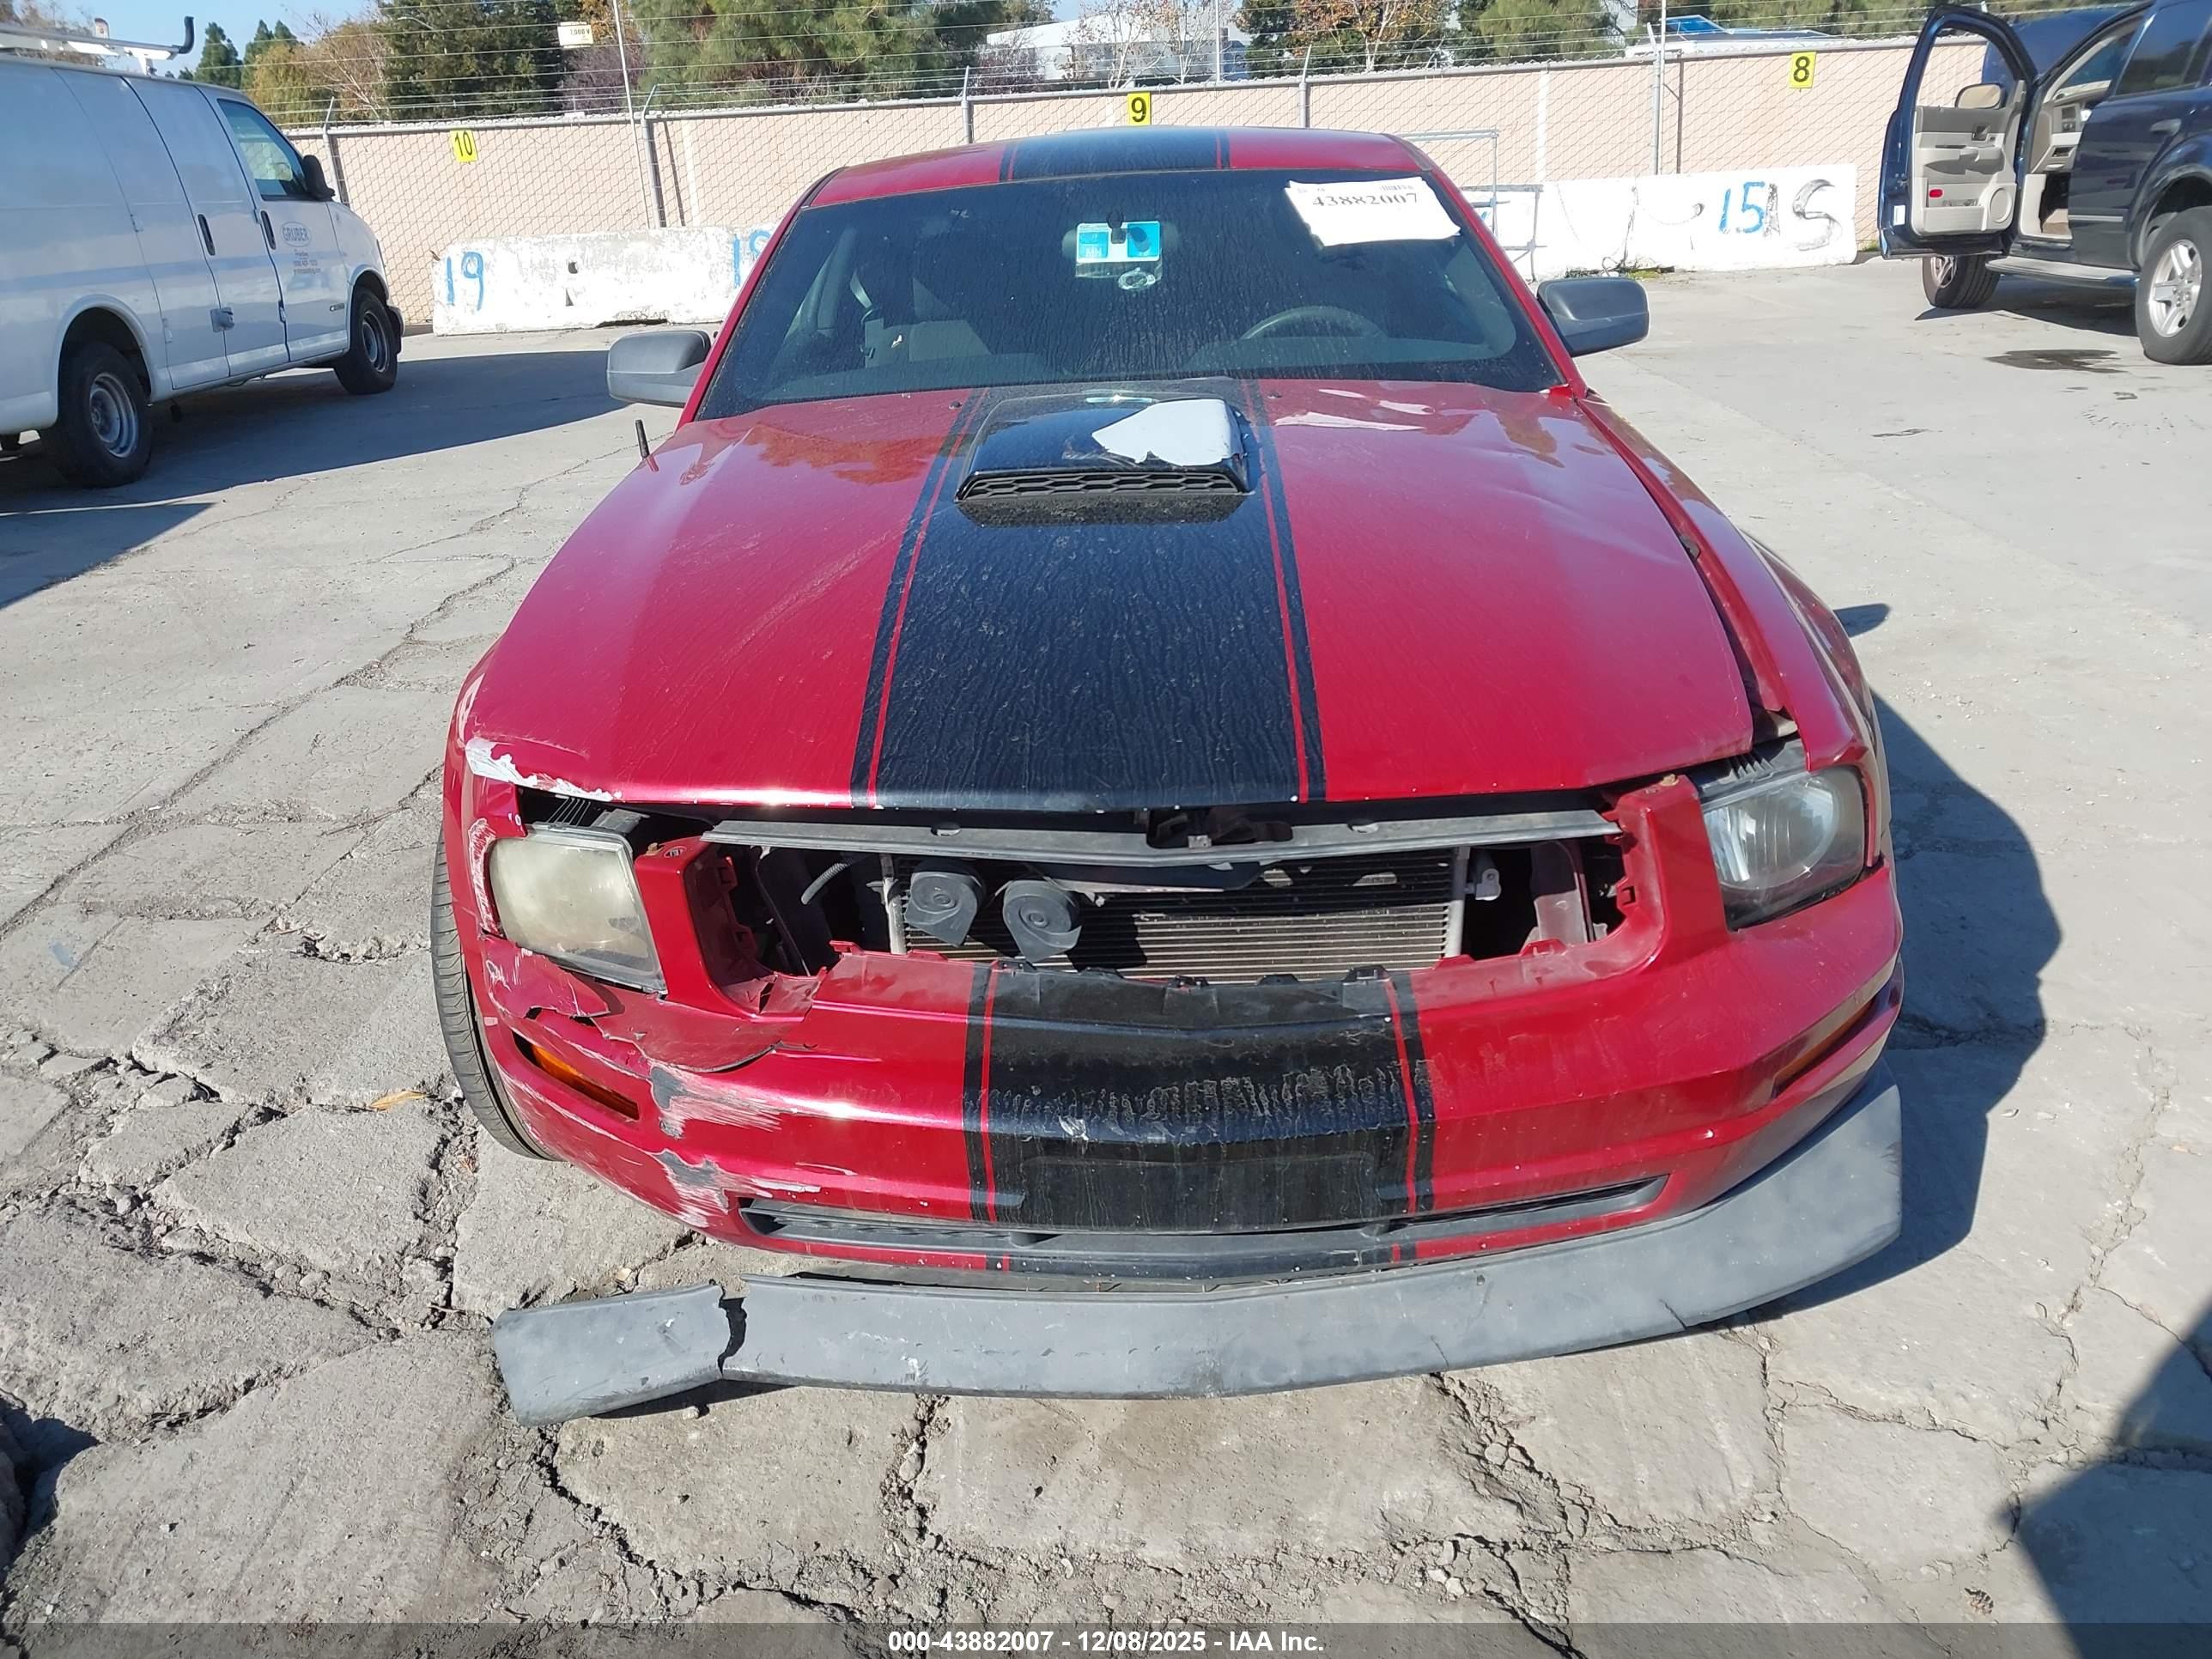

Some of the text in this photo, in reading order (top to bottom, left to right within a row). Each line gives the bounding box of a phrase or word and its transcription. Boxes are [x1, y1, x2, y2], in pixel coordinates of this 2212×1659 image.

[1794, 56, 1810, 82] 8
[1131, 97, 1146, 122] 9
[455, 131, 472, 156] 10
[1313, 192, 1417, 207] 43882007
[1718, 181, 1765, 234] 15
[447, 252, 483, 310] 19
